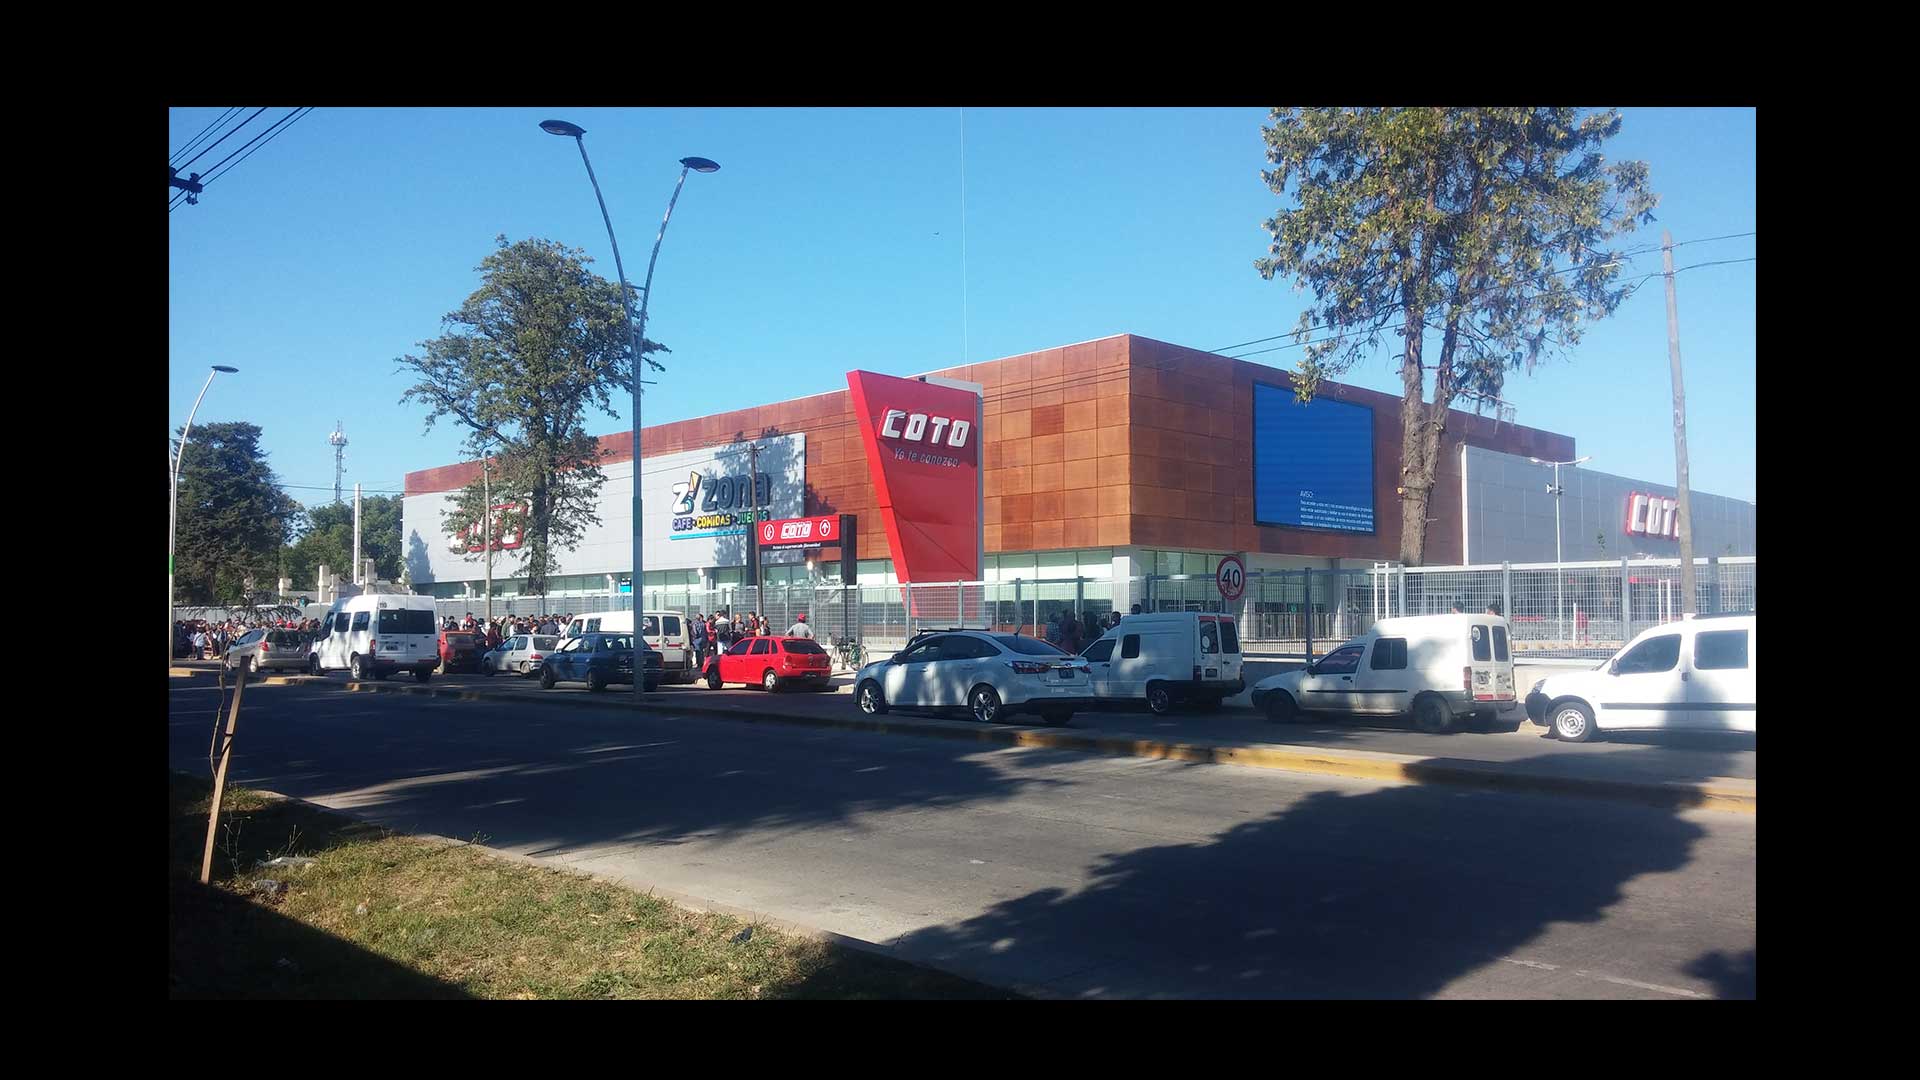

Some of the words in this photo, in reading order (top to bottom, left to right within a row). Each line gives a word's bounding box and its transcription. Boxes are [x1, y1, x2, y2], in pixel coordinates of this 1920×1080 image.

[881, 409, 970, 448] COTO
[696, 514, 732, 529] COMIDAS
[1631, 494, 1680, 538] COT
[781, 521, 812, 538] COTO
[1222, 568, 1241, 588] 40
